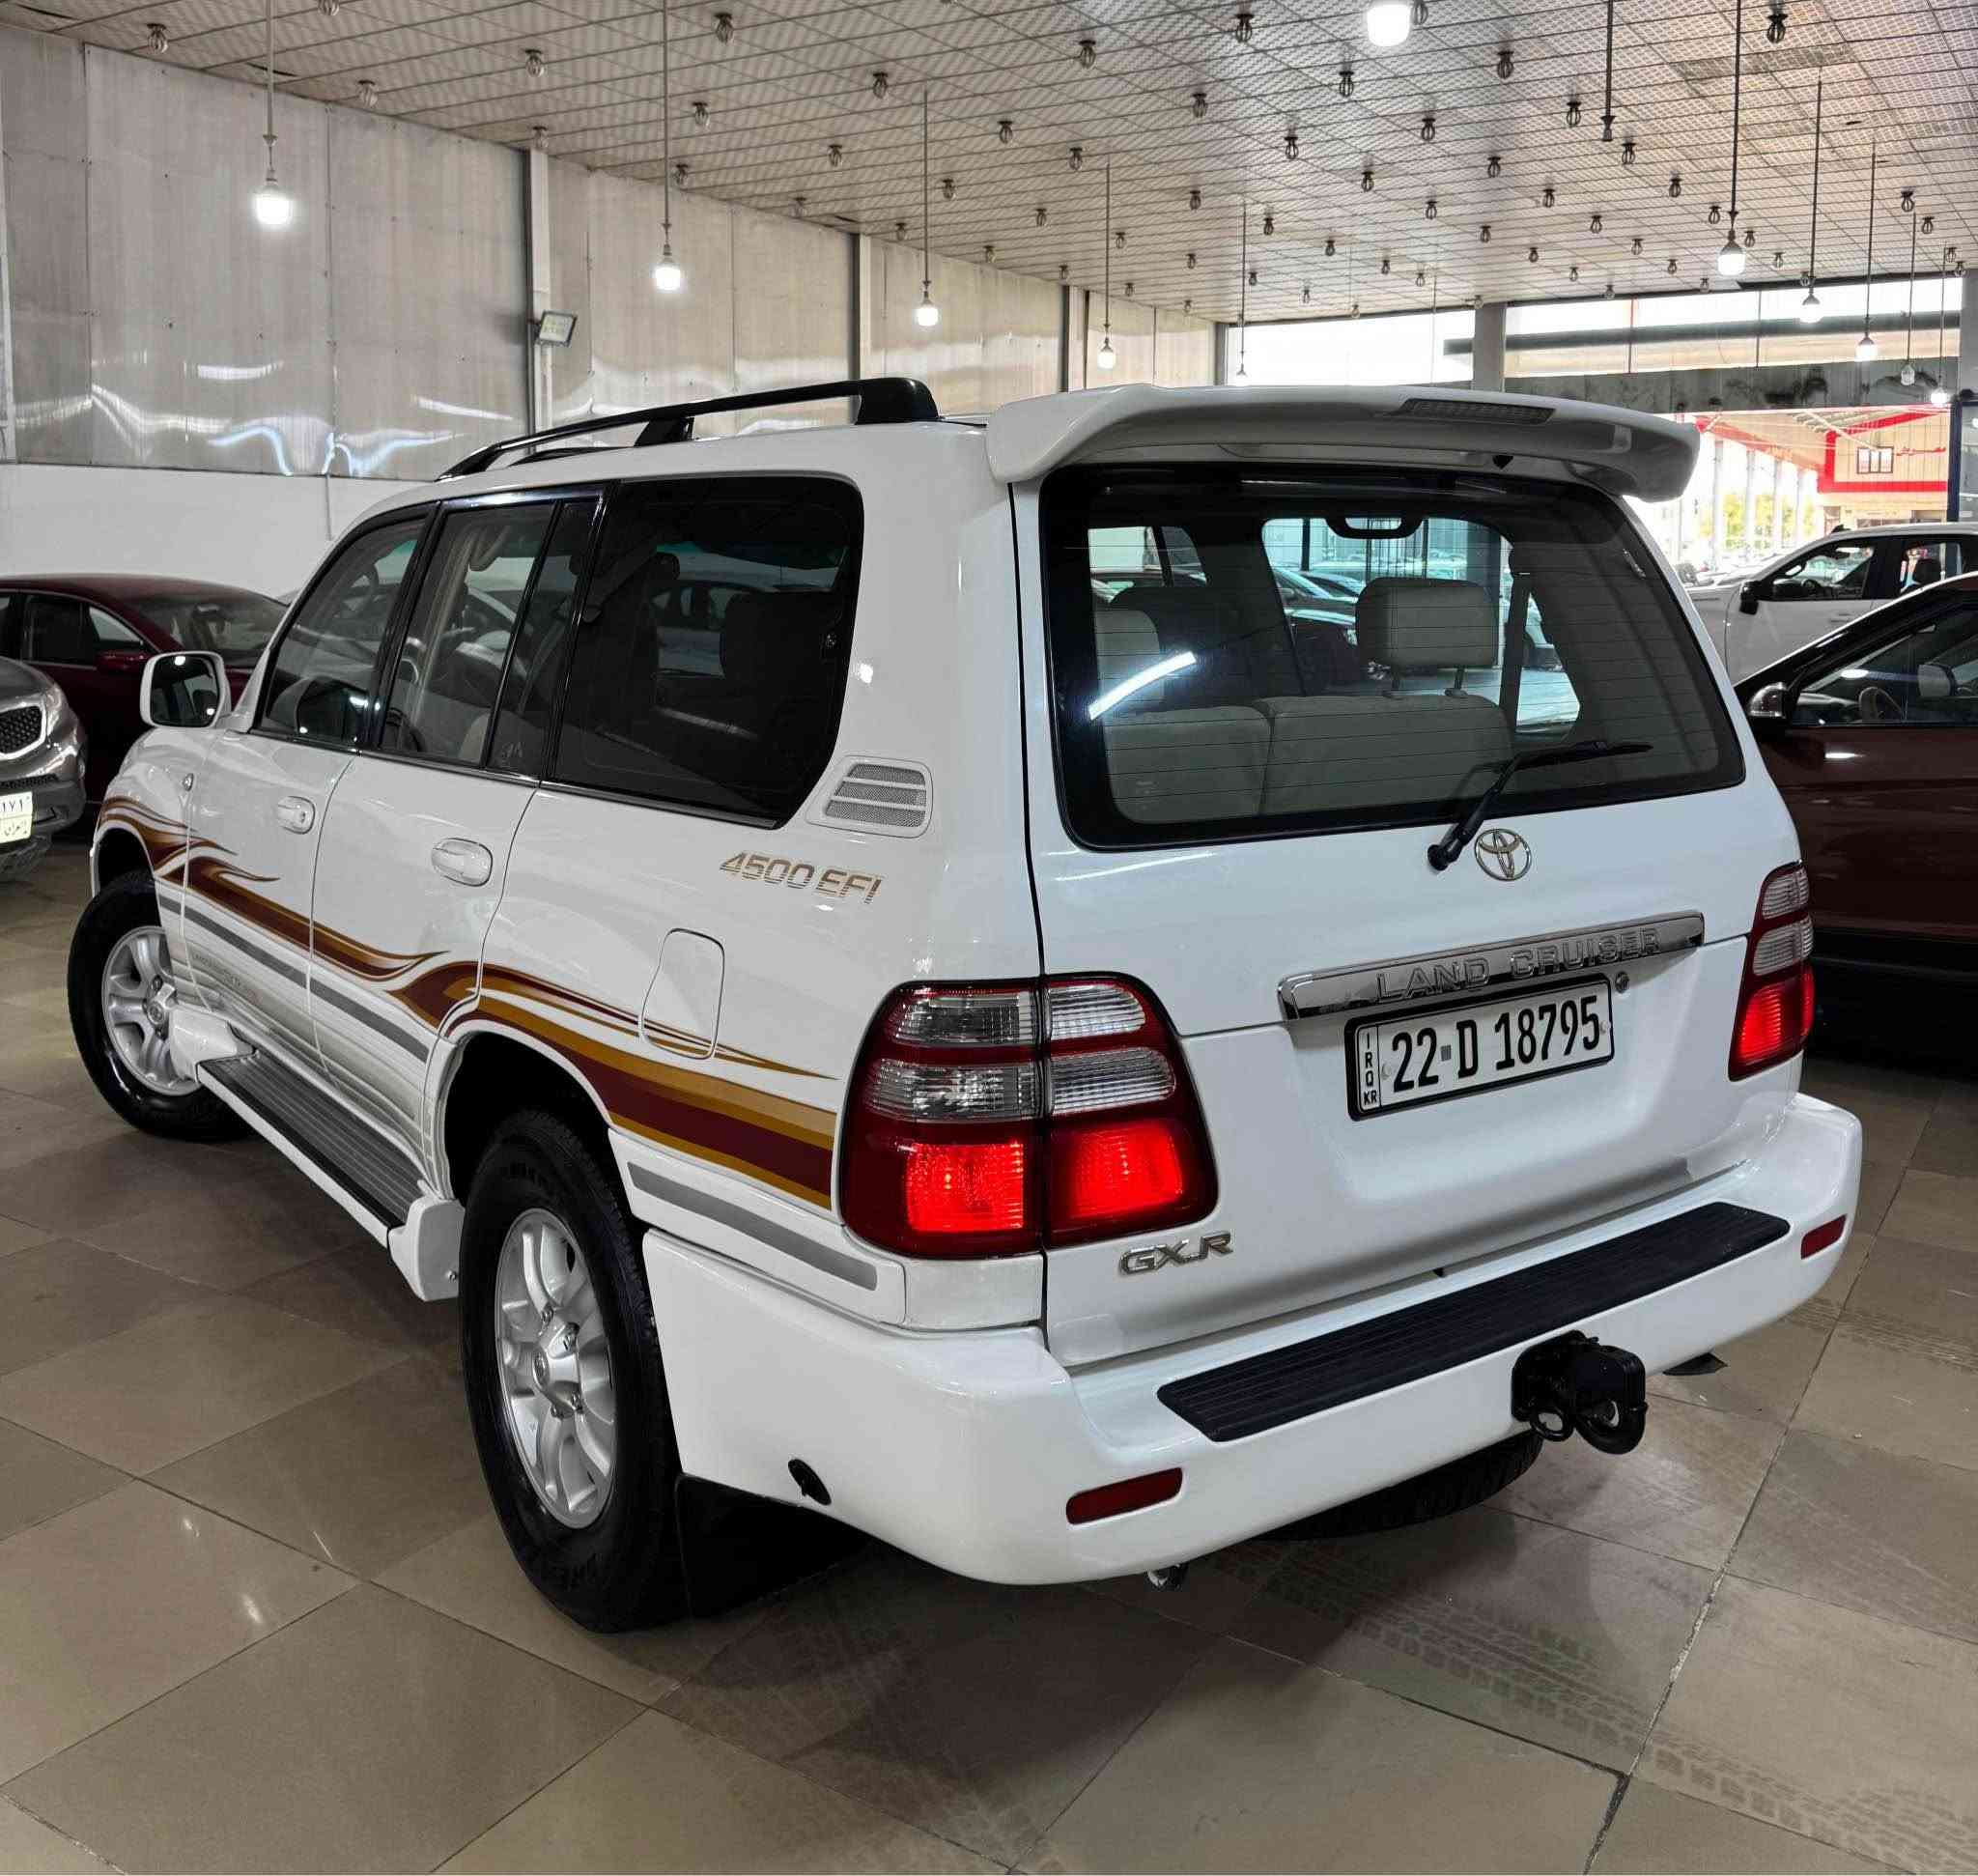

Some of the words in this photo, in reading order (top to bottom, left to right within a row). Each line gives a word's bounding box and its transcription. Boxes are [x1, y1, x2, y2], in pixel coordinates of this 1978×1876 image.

[720, 852, 815, 890] 4500
[816, 868, 882, 904] EFI
[1375, 957, 1490, 1002] LAND
[1509, 927, 1661, 979] CRUISER
[1494, 995, 1600, 1070] 18795
[1363, 1090, 1378, 1106] KR
[1119, 1231, 1234, 1274] GXR
